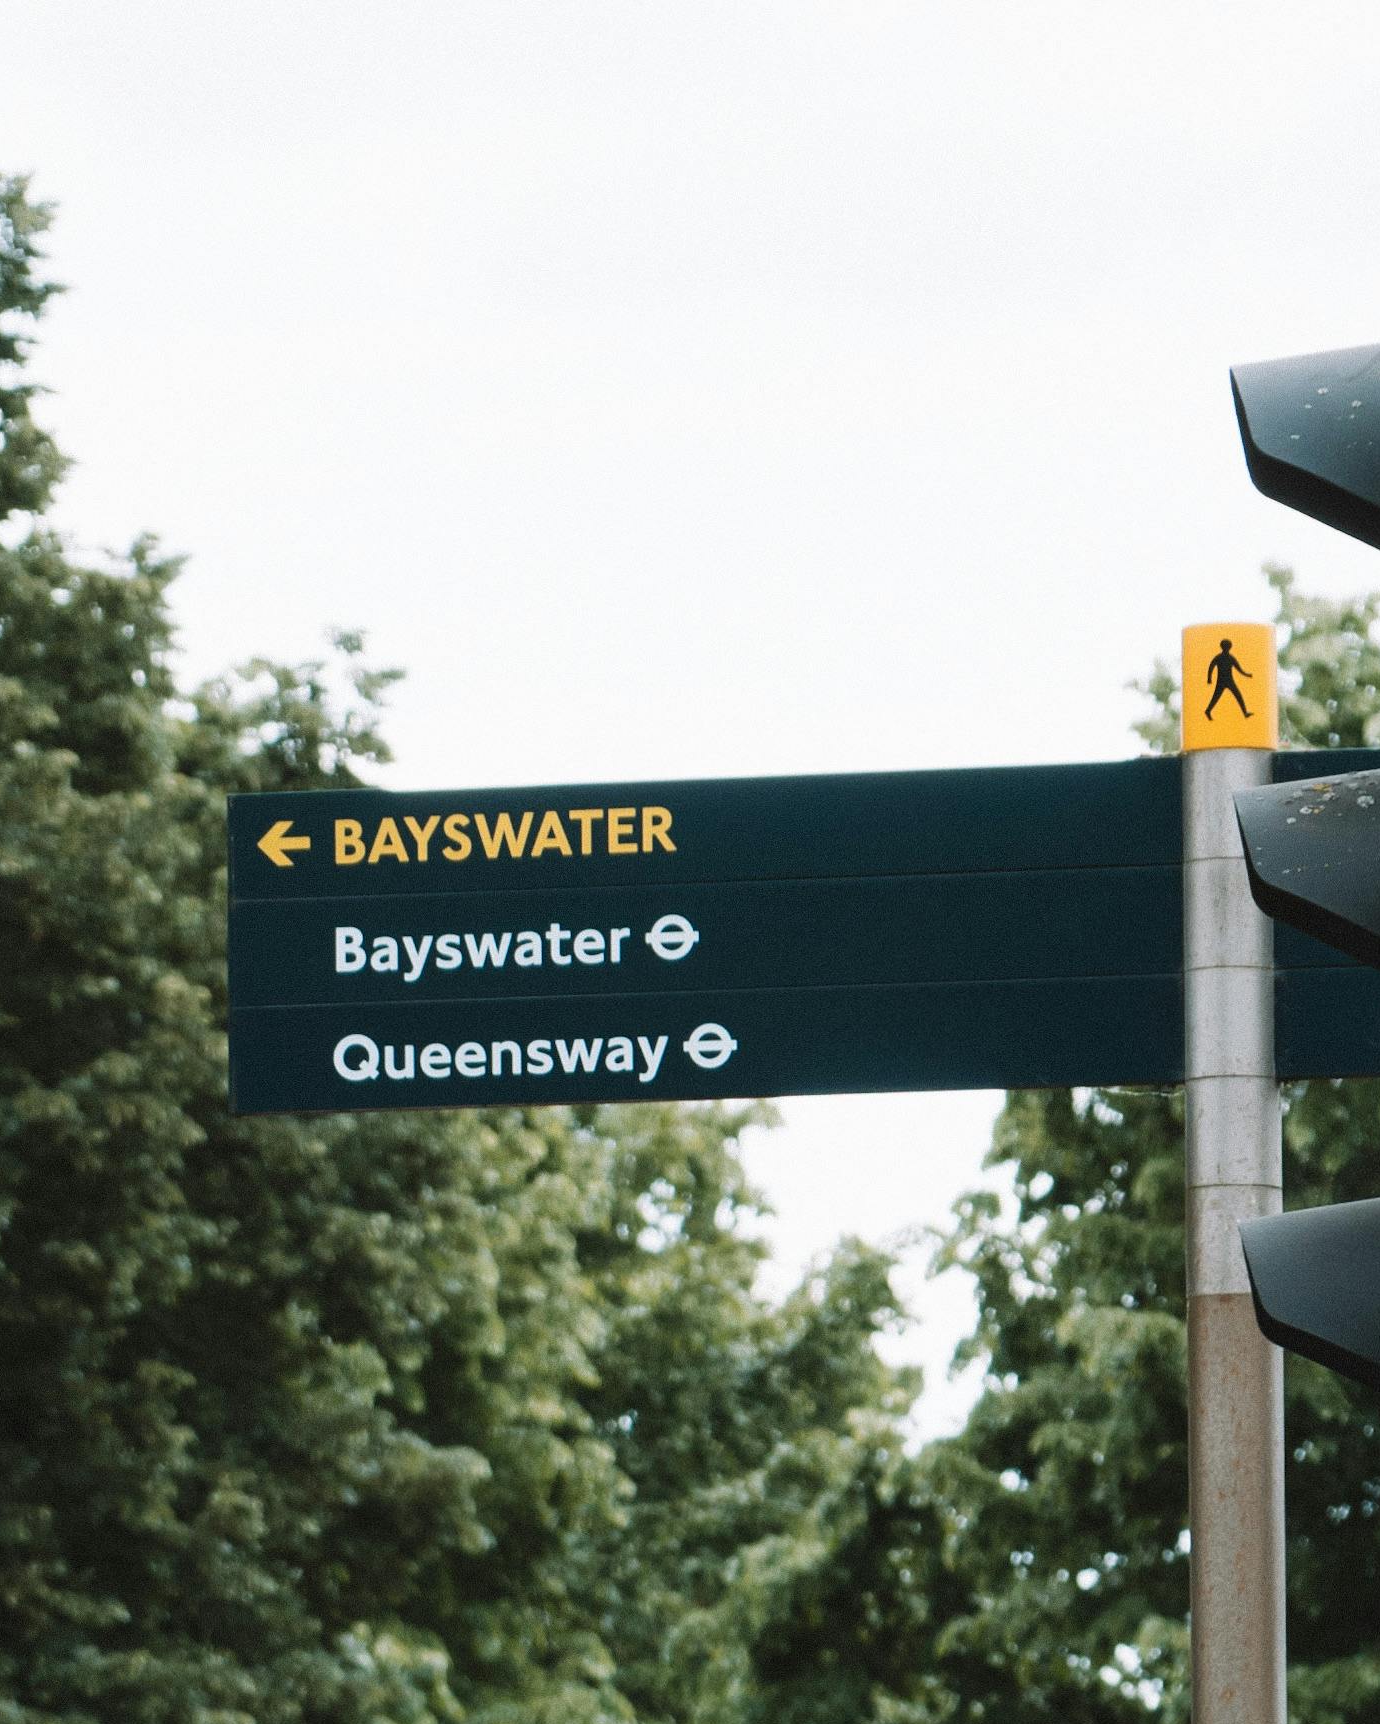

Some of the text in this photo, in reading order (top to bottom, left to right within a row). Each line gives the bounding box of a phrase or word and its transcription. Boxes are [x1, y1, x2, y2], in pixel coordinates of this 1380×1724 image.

[335, 807, 676, 864] BAYSWATER
[336, 923, 630, 982] Bayswater
[333, 1034, 668, 1082] Queensway
